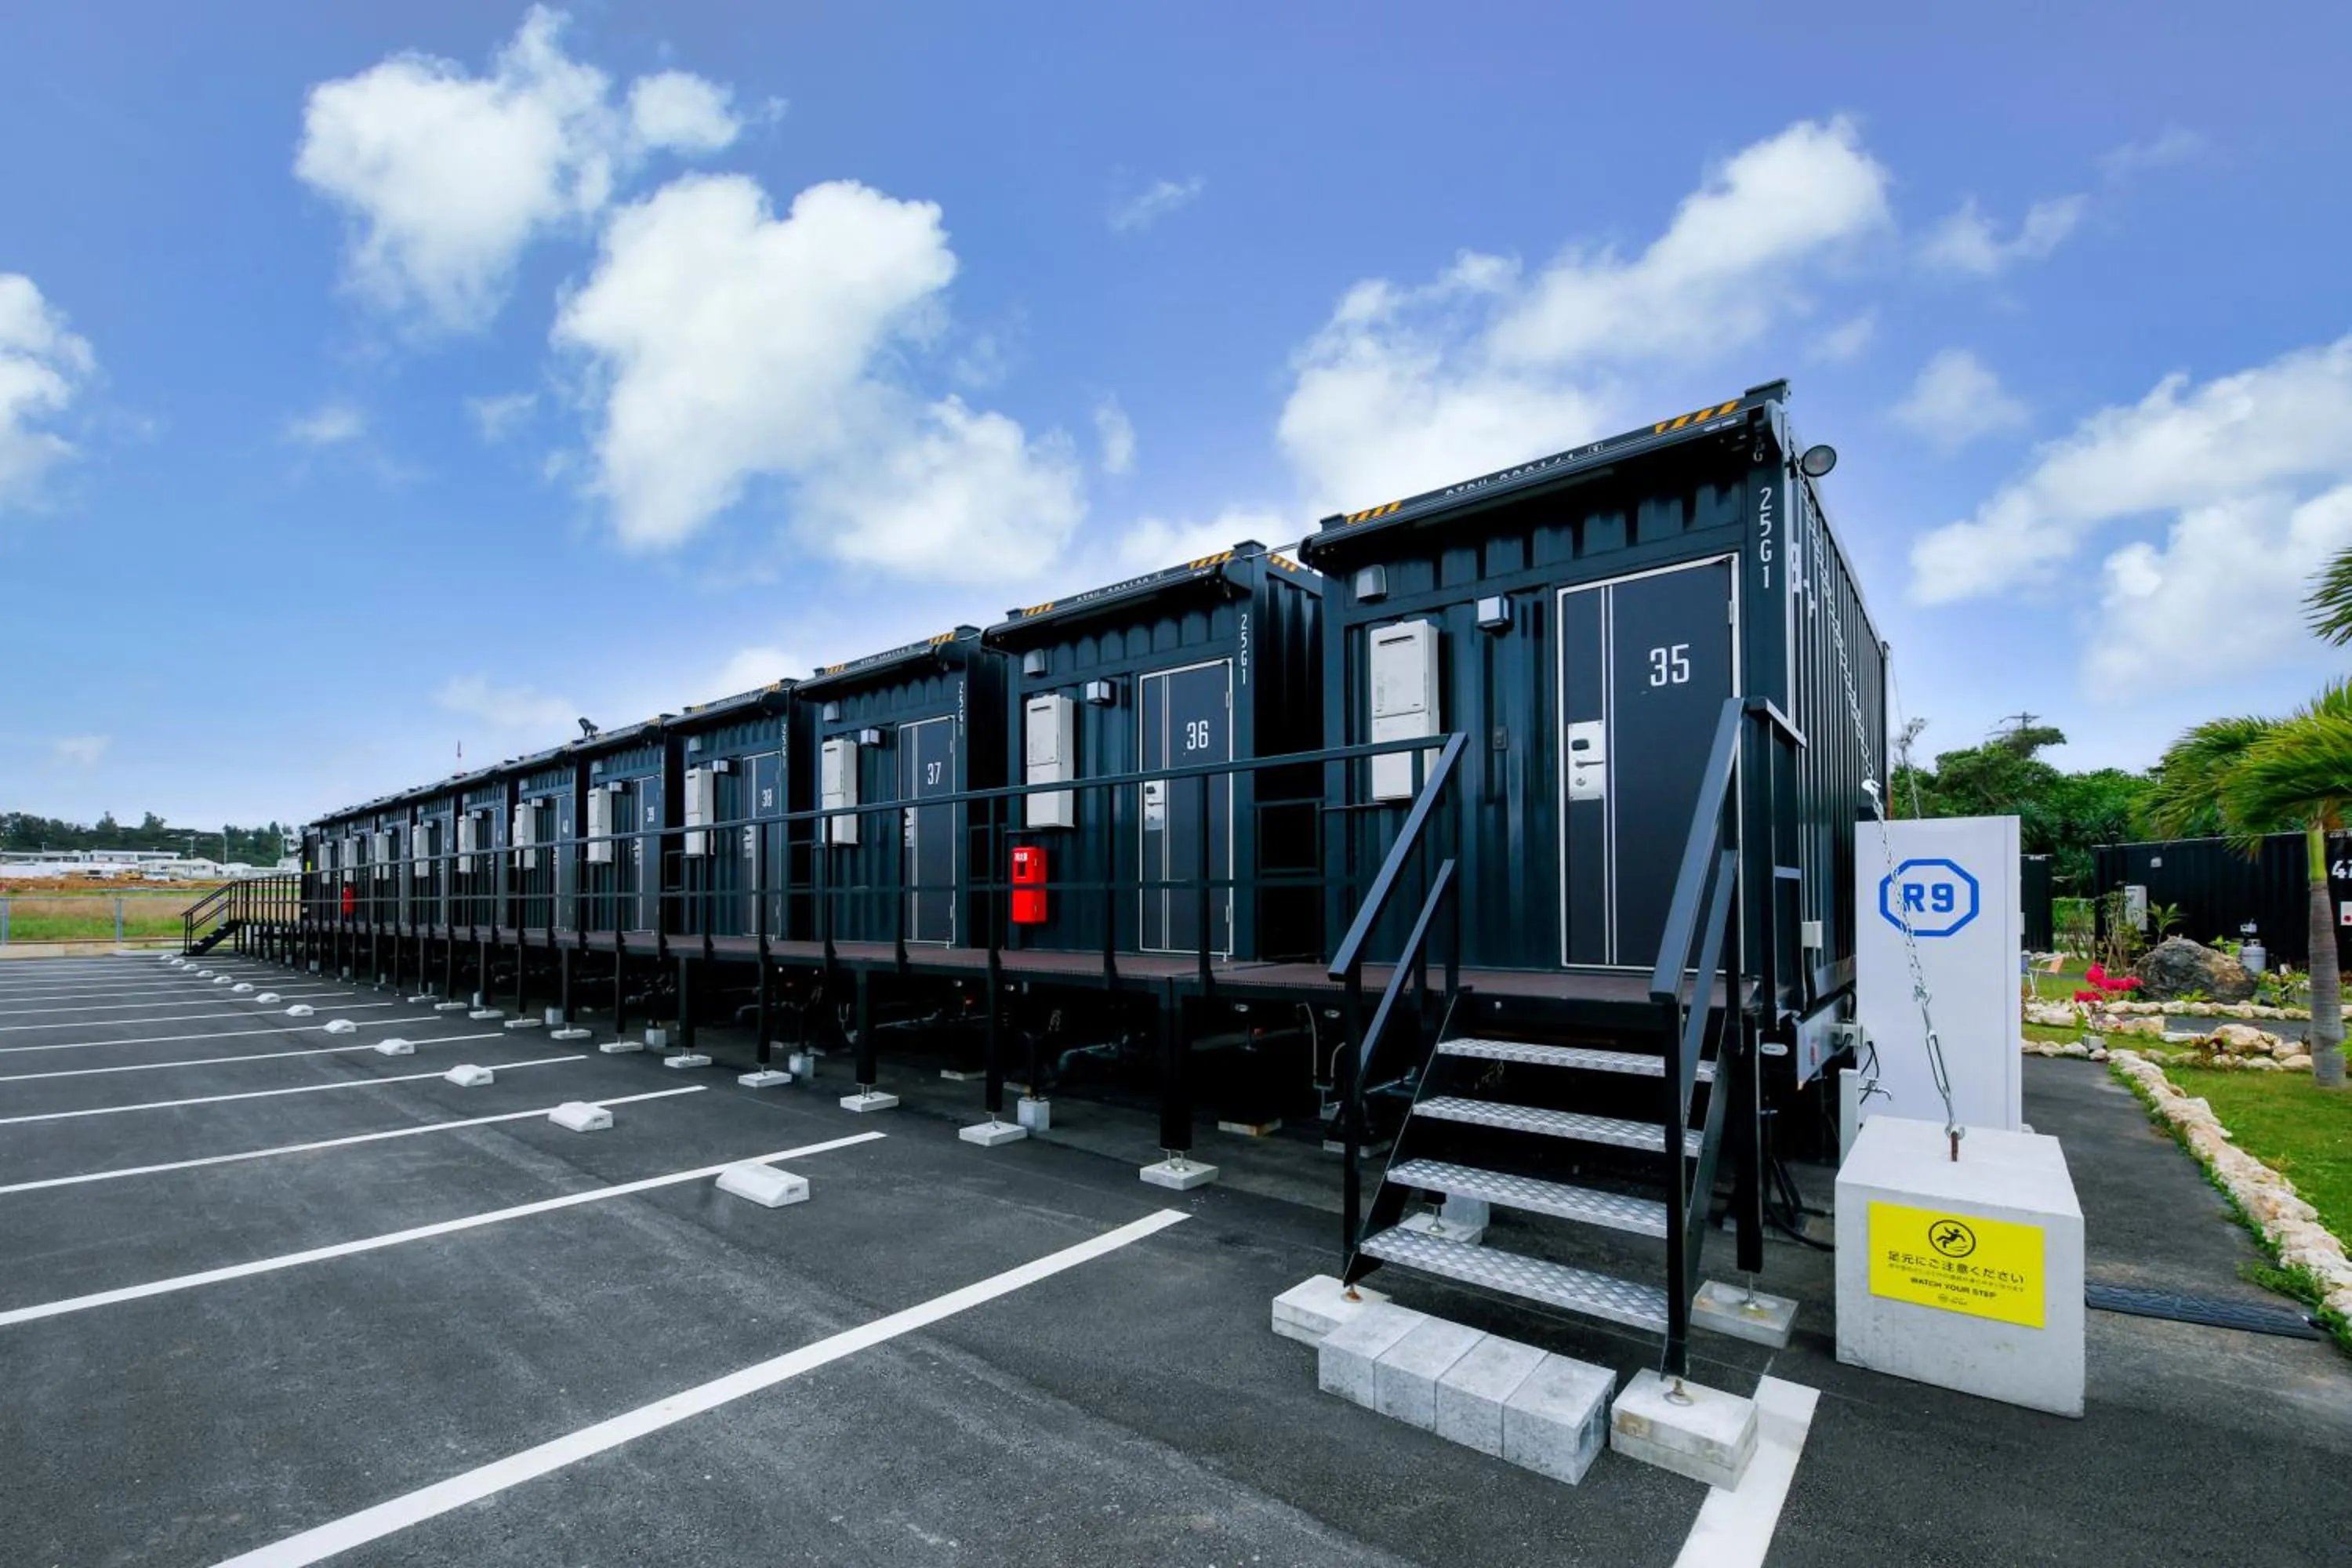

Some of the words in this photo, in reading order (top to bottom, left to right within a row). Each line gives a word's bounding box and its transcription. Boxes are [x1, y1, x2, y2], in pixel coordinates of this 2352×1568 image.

[1759, 487, 1773, 588] 25G1
[1650, 644, 1690, 687] 35
[1186, 720, 1209, 750] 36
[927, 761, 942, 785] 37
[1903, 884, 1954, 912] R9
[1888, 1250, 2024, 1284] 足元にご注意ください
[1910, 1276, 1942, 1290] WATCH
[1944, 1283, 1970, 1294] YOUR
[1972, 1287, 1998, 1298] STEP
